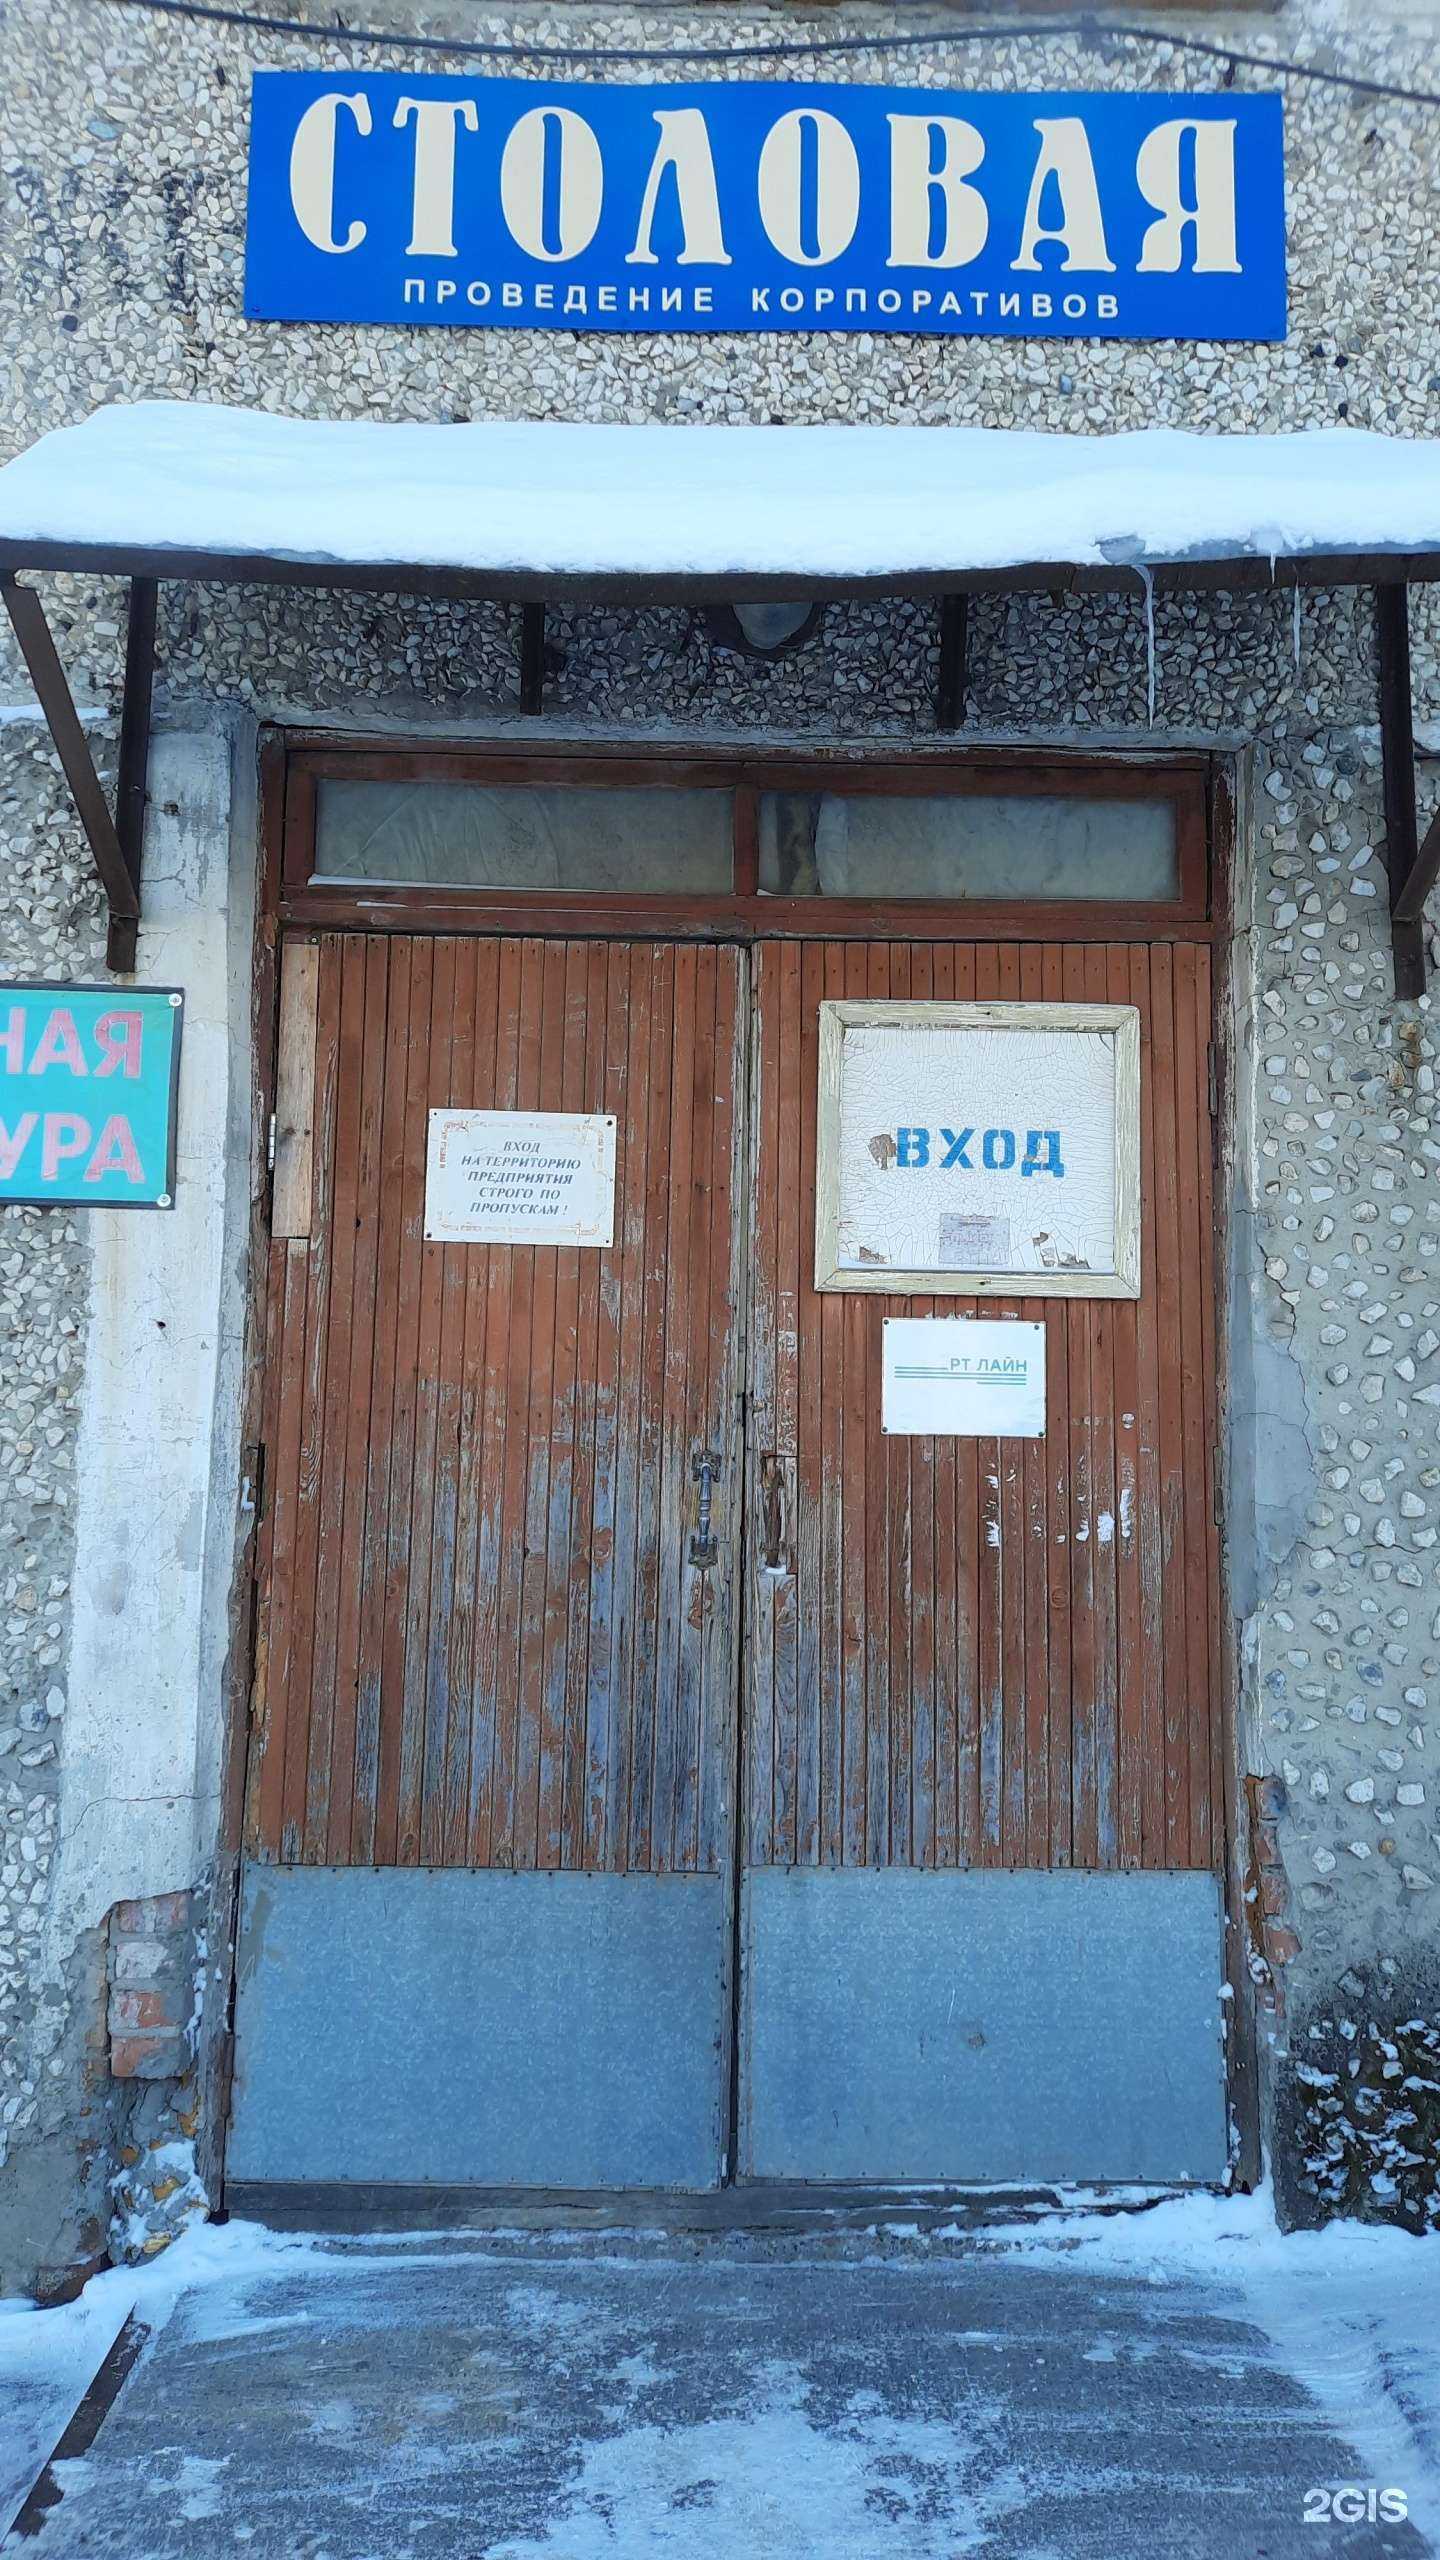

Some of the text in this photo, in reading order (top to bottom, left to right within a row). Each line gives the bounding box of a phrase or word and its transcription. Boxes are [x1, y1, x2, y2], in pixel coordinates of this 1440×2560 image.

[289, 92, 1239, 273] СТОЛОВАЯ
[404, 279, 1119, 318] ПРОВЕДЕНИЕ КОРПОРАТИВОВ
[503, 1141, 541, 1154] ВХОД
[896, 1127, 1065, 1178] ВХОД
[461, 1156, 581, 1169] НА ТЕРРИТОРИЮ
[468, 1171, 573, 1184] ПРЕДПРИЯТИЯ
[479, 1187, 560, 1199] СТРОГО ПО
[976, 1356, 1027, 1372] ЛАЙН
